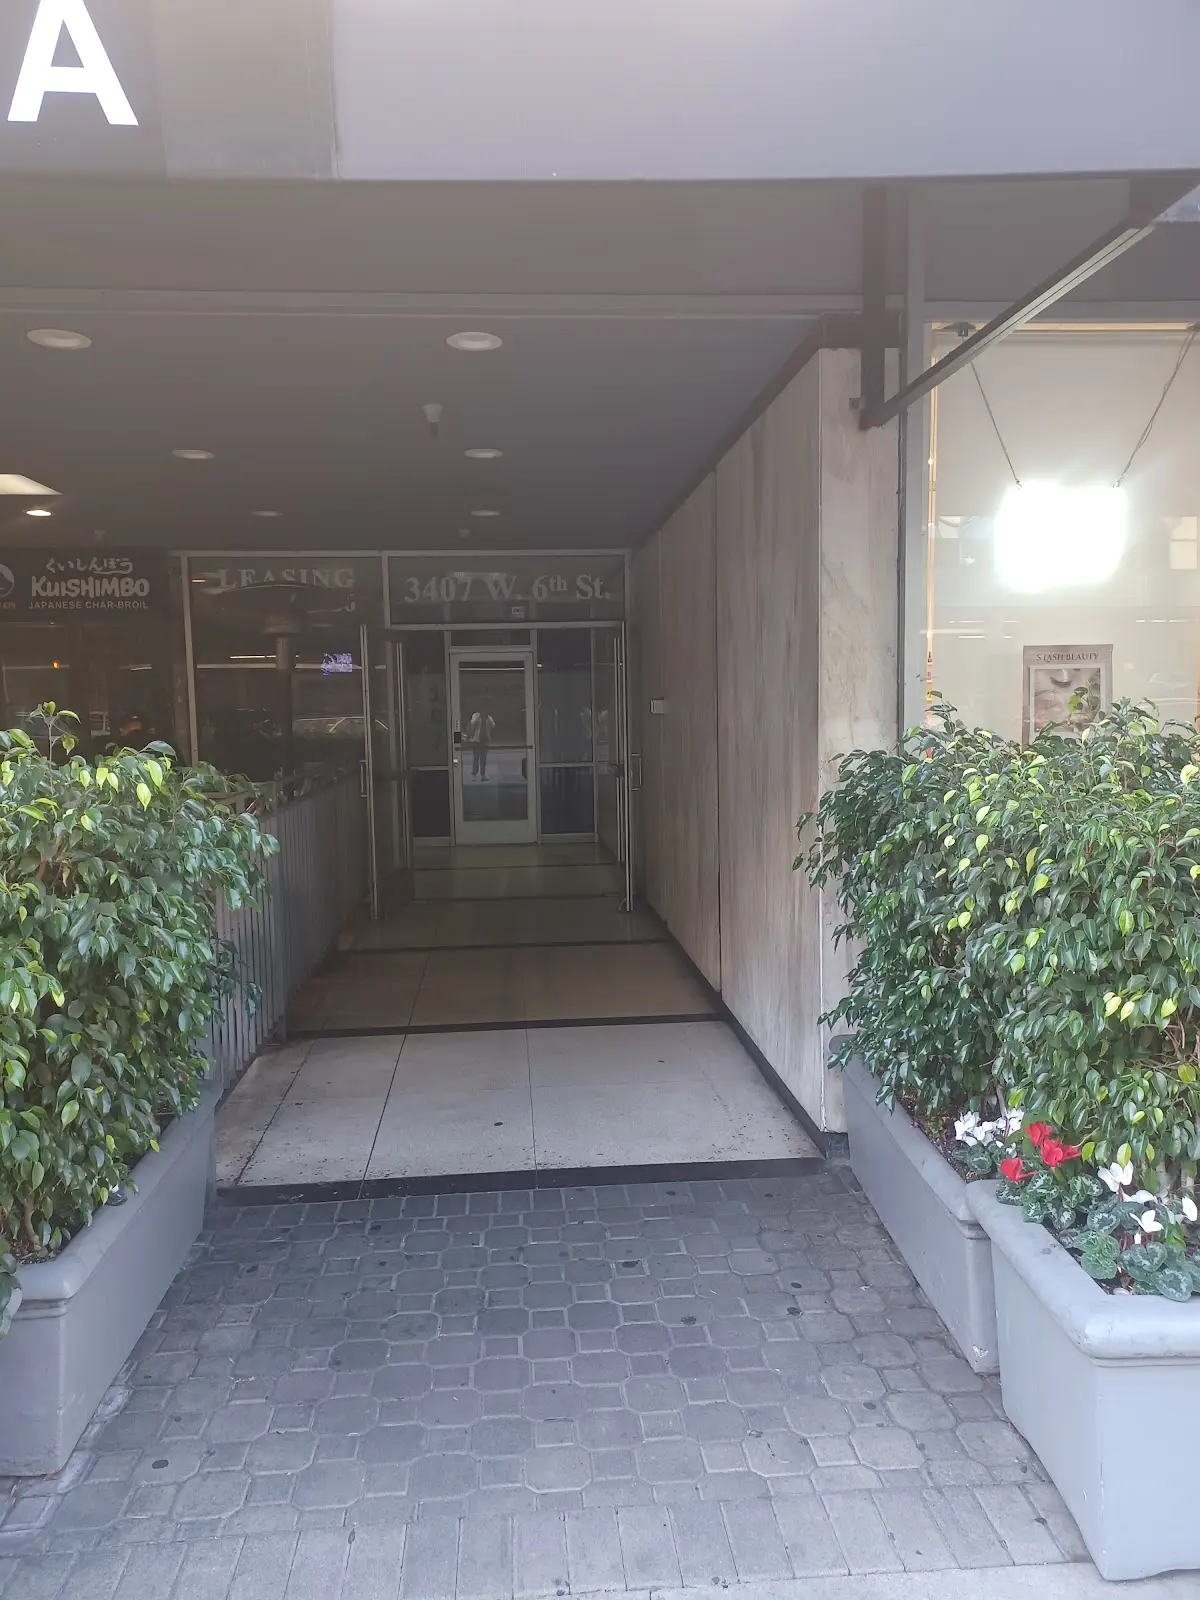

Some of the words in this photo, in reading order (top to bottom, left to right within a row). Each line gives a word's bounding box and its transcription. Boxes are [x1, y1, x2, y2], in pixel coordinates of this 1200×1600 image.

[7, 0, 139, 126] A
[217, 568, 356, 589] LEASING
[404, 573, 473, 603] 3407
[532, 574, 568, 601] 6th
[575, 573, 612, 600] St.
[28, 601, 83, 610] JAPANESE
[85, 600, 149, 610] CHAR-BROIL
[1066, 652, 1099, 661] BEAUTY
